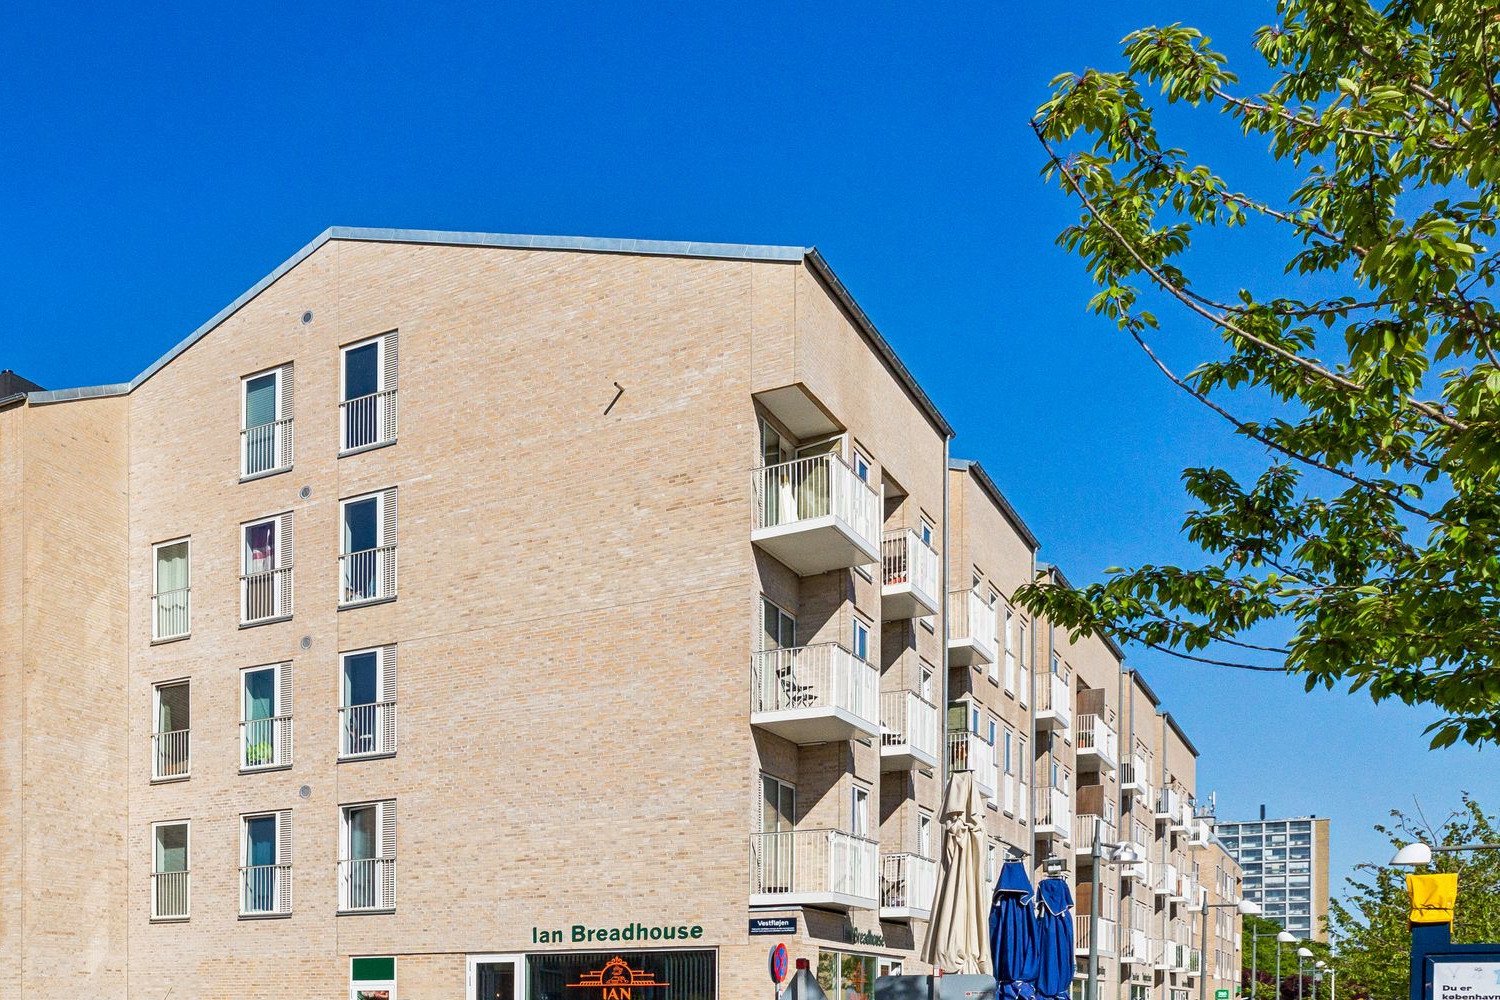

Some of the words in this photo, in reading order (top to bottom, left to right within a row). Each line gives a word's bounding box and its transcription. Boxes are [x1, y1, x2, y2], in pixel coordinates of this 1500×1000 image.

[757, 919, 789, 928] Vestfløjen
[532, 927, 563, 944] Ian
[571, 922, 704, 943] Breadhouse
[602, 987, 631, 1000] IAN
